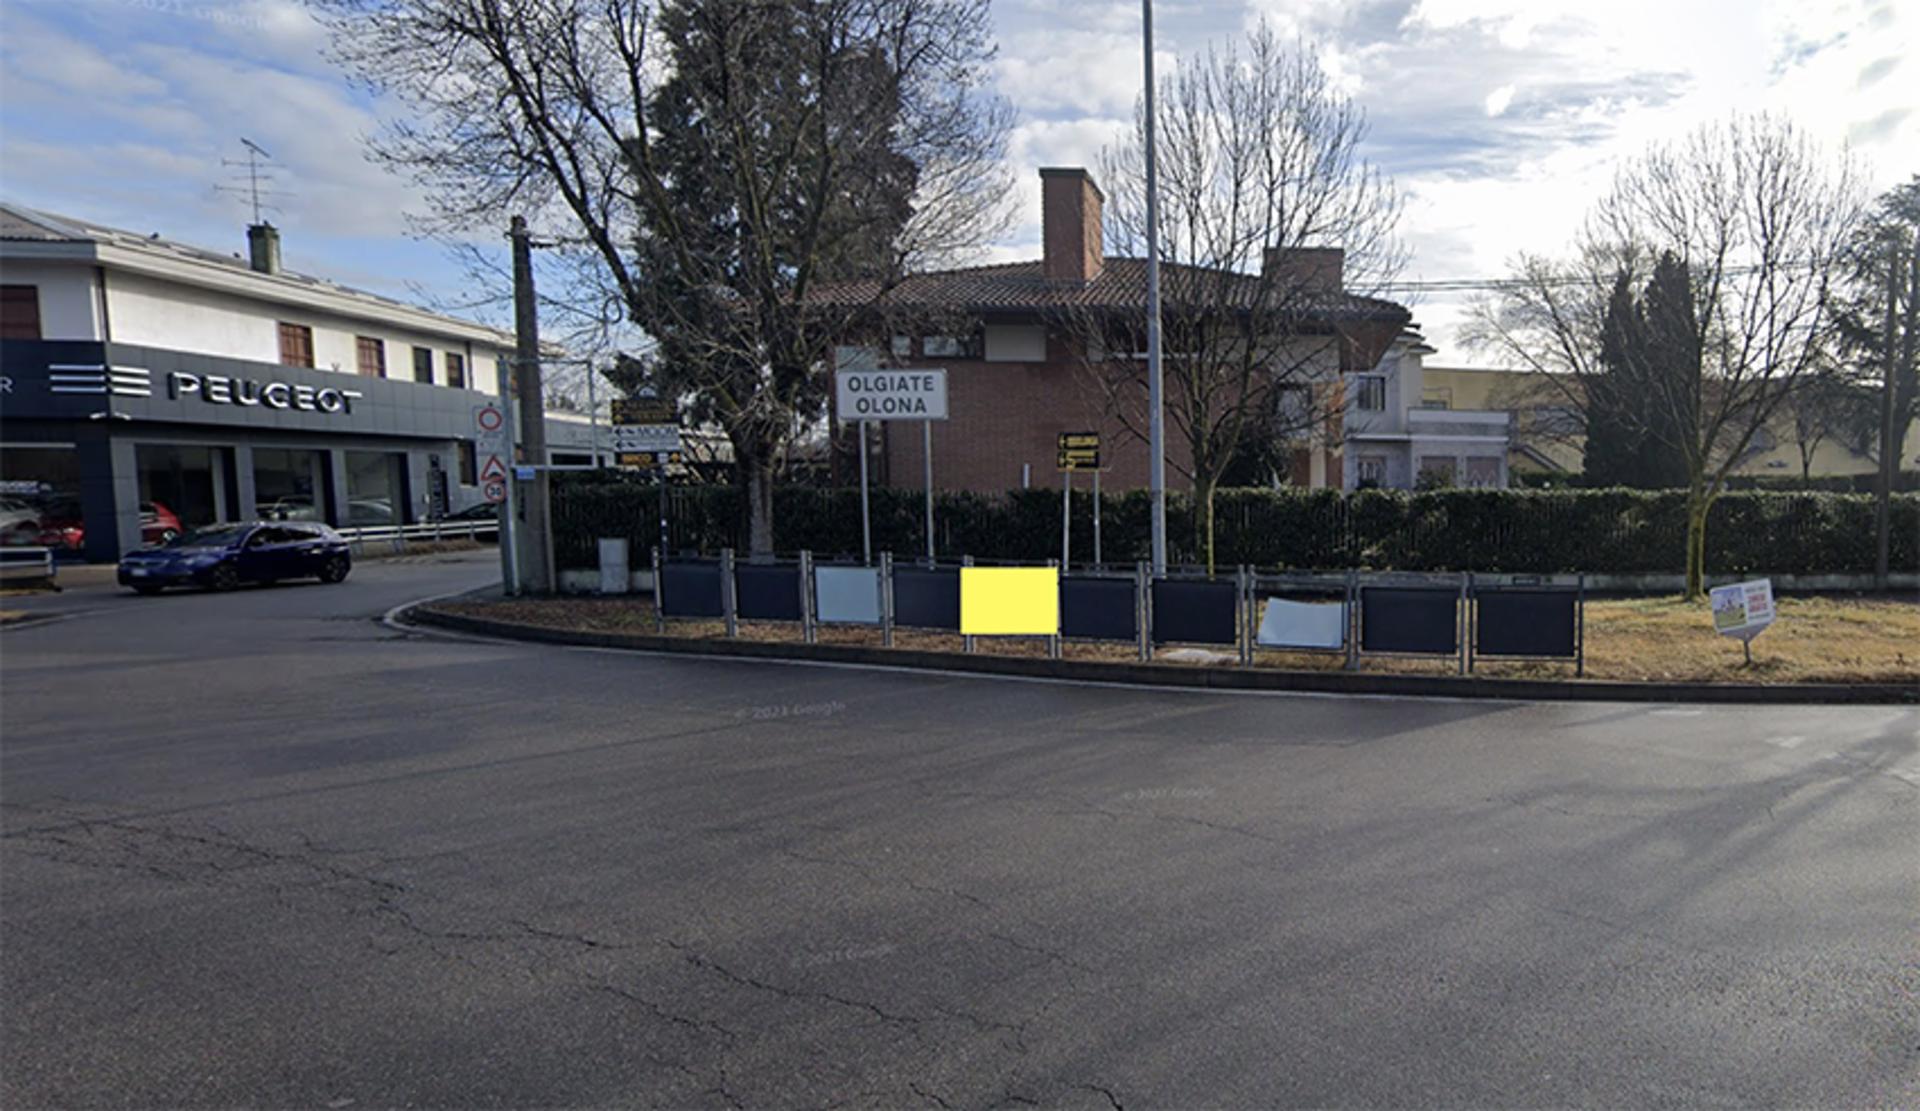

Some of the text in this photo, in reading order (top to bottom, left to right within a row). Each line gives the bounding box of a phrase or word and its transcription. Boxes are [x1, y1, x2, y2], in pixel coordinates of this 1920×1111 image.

[168, 371, 362, 414] PEUGEOT
[848, 375, 934, 393] OLGIATE
[856, 397, 927, 414] OLONA
